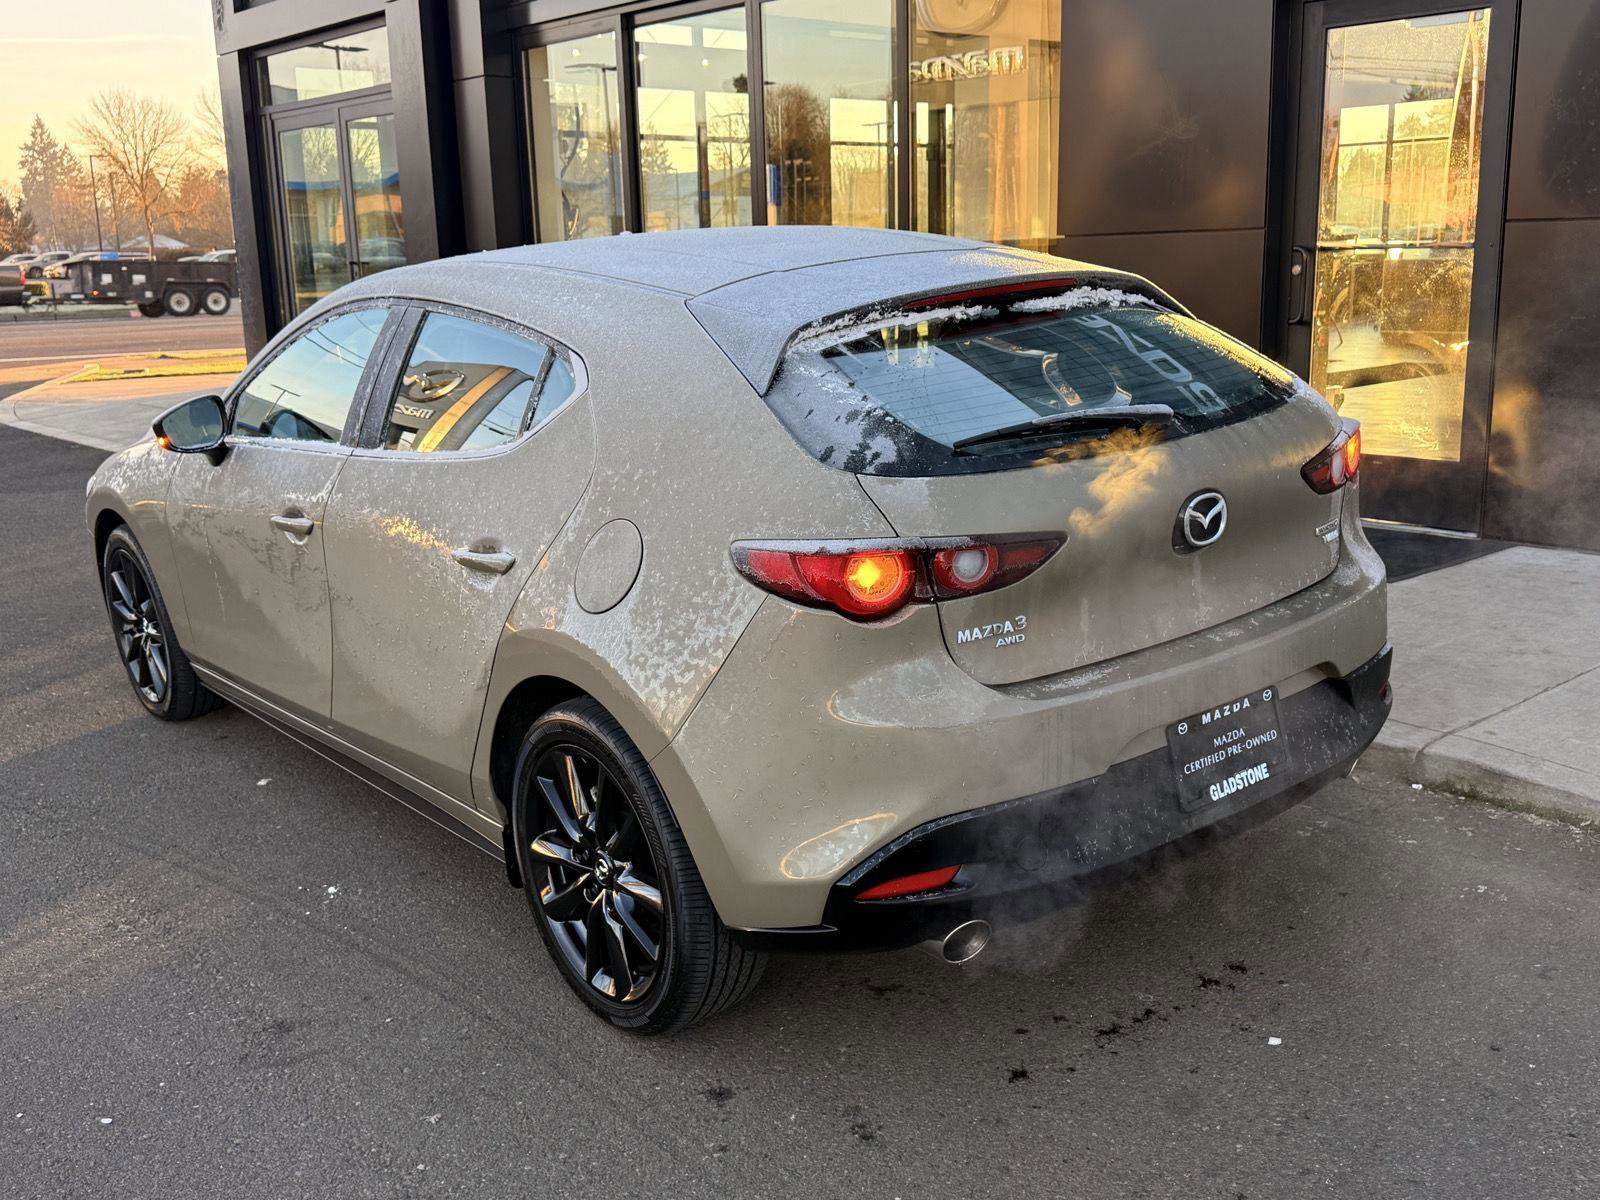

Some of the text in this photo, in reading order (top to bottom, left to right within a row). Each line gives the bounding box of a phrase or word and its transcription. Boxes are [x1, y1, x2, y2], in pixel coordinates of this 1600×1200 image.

[995, 634, 1026, 648] AWD
[1201, 698, 1251, 725] MAZDA
[1213, 728, 1246, 748] MAZDA
[1184, 729, 1278, 775] CERTIFIED PRE-OWNED
[1209, 762, 1270, 801] GLADSTONE
